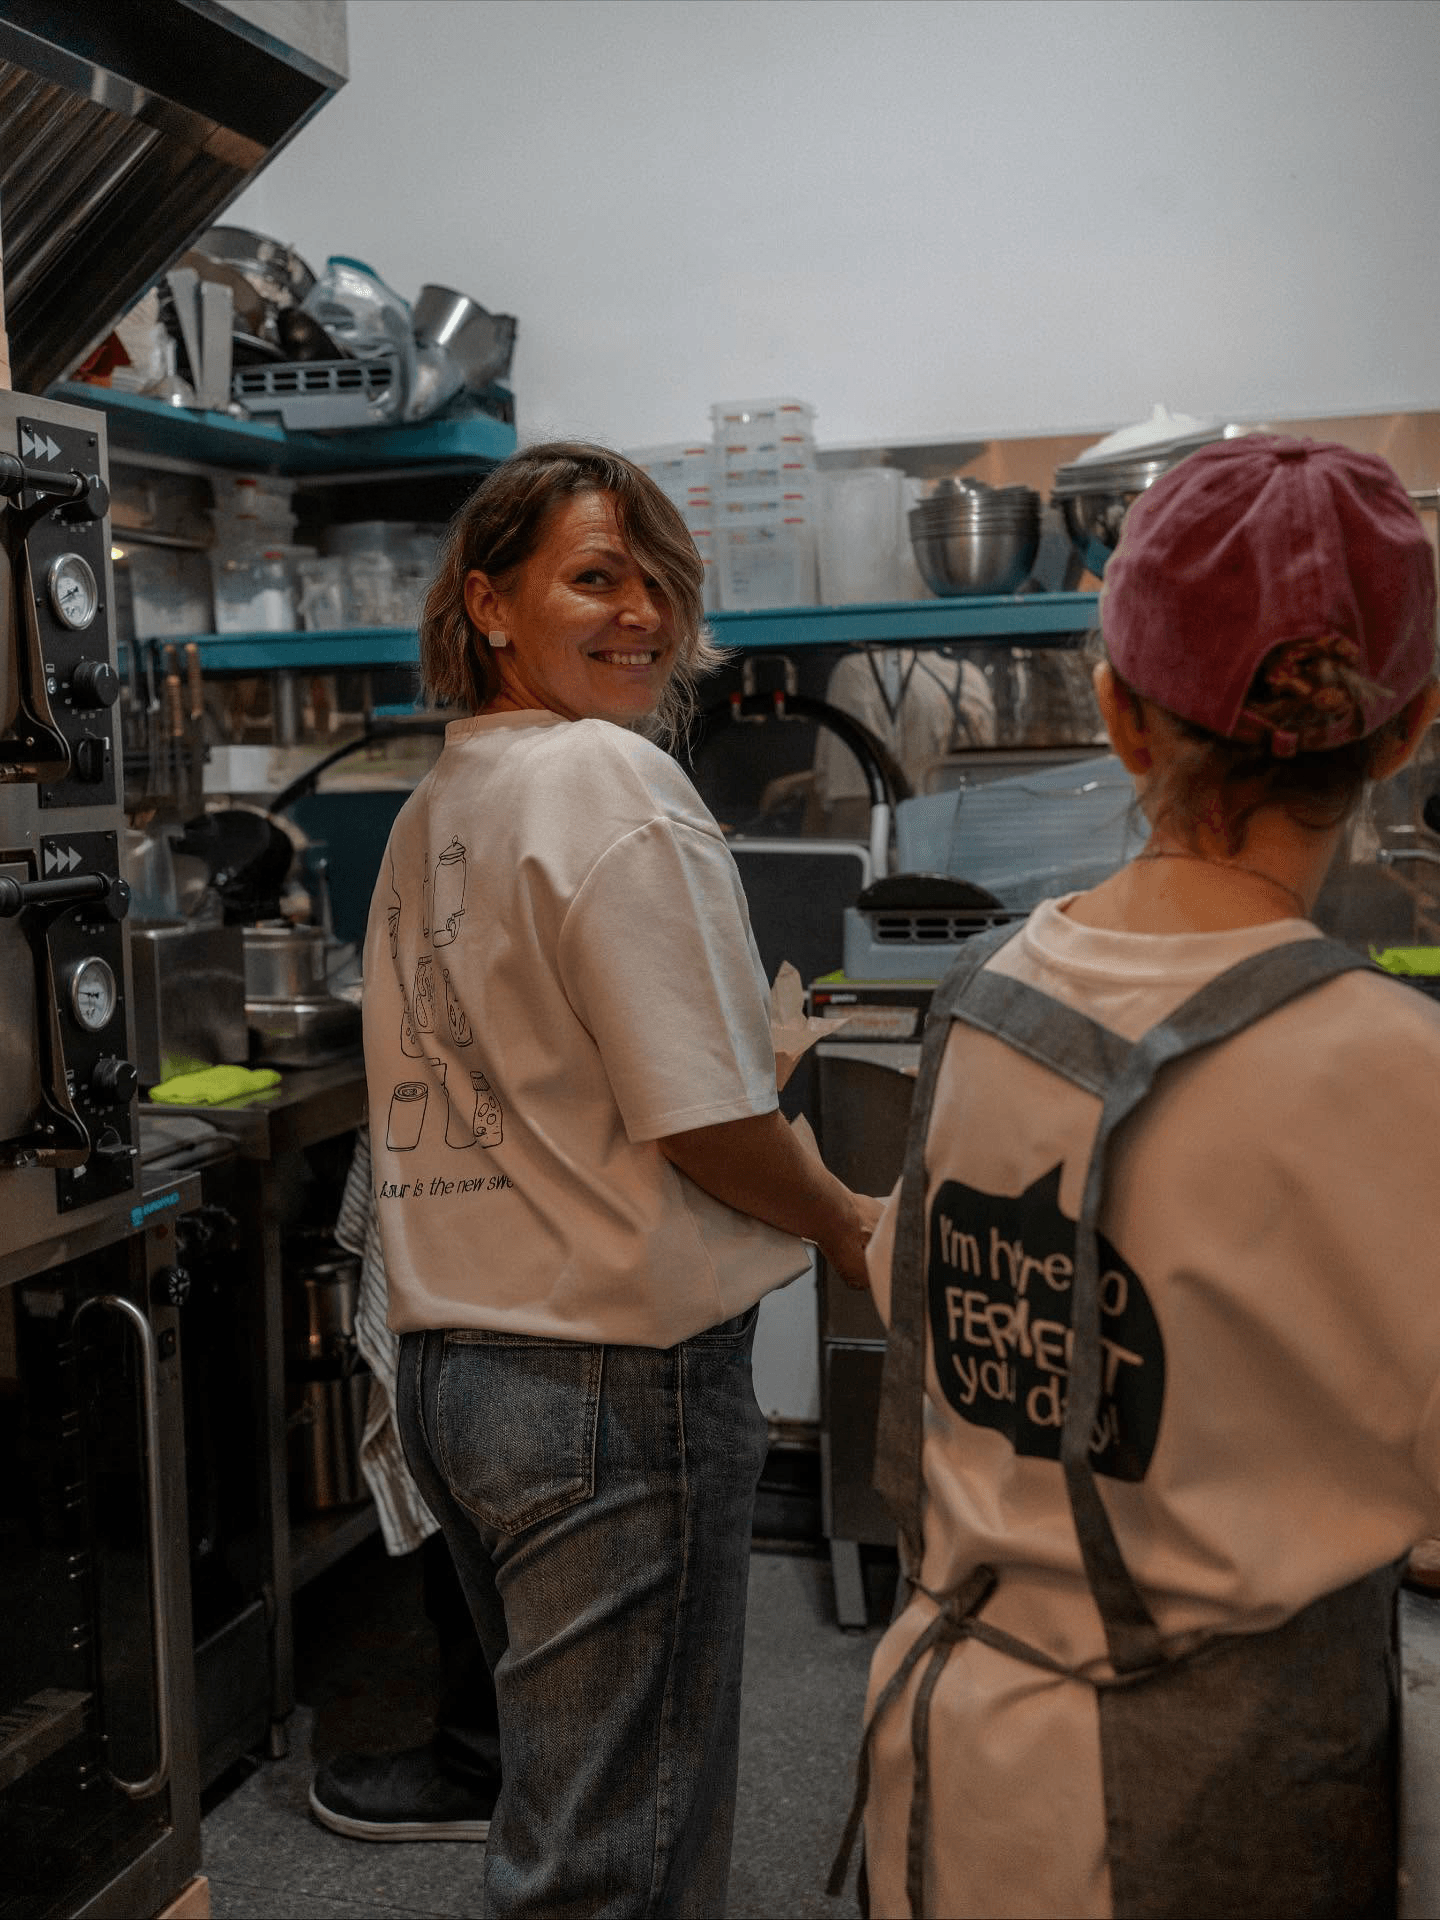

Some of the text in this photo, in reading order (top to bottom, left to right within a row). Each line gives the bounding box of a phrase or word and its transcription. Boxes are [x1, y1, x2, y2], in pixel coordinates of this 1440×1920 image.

[413, 1179, 423, 1197] is
[429, 1176, 455, 1196] the
[456, 1177, 485, 1194] new
[940, 1214, 981, 1277] I'm
[990, 1226, 1073, 1296] hre
